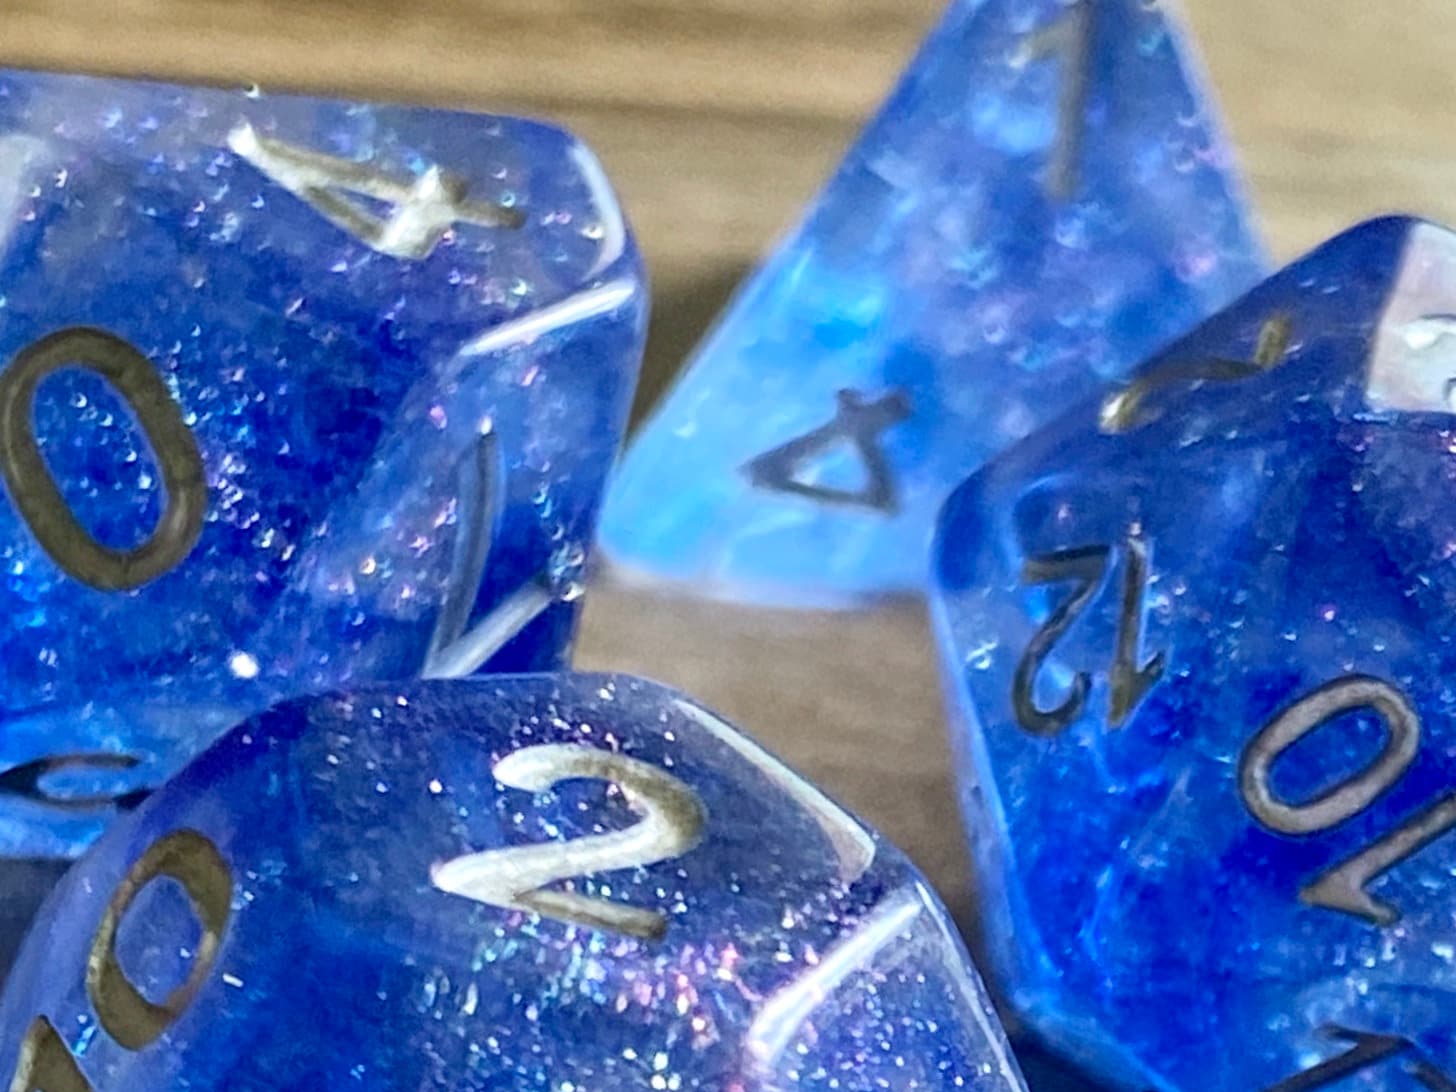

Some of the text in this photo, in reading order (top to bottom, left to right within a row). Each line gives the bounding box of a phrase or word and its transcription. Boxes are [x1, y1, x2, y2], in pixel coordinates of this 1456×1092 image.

[228, 122, 526, 262] 4
[1, 327, 205, 591] 0
[738, 387, 912, 517] 4
[1012, 536, 1168, 738] 12
[430, 742, 708, 942] 2
